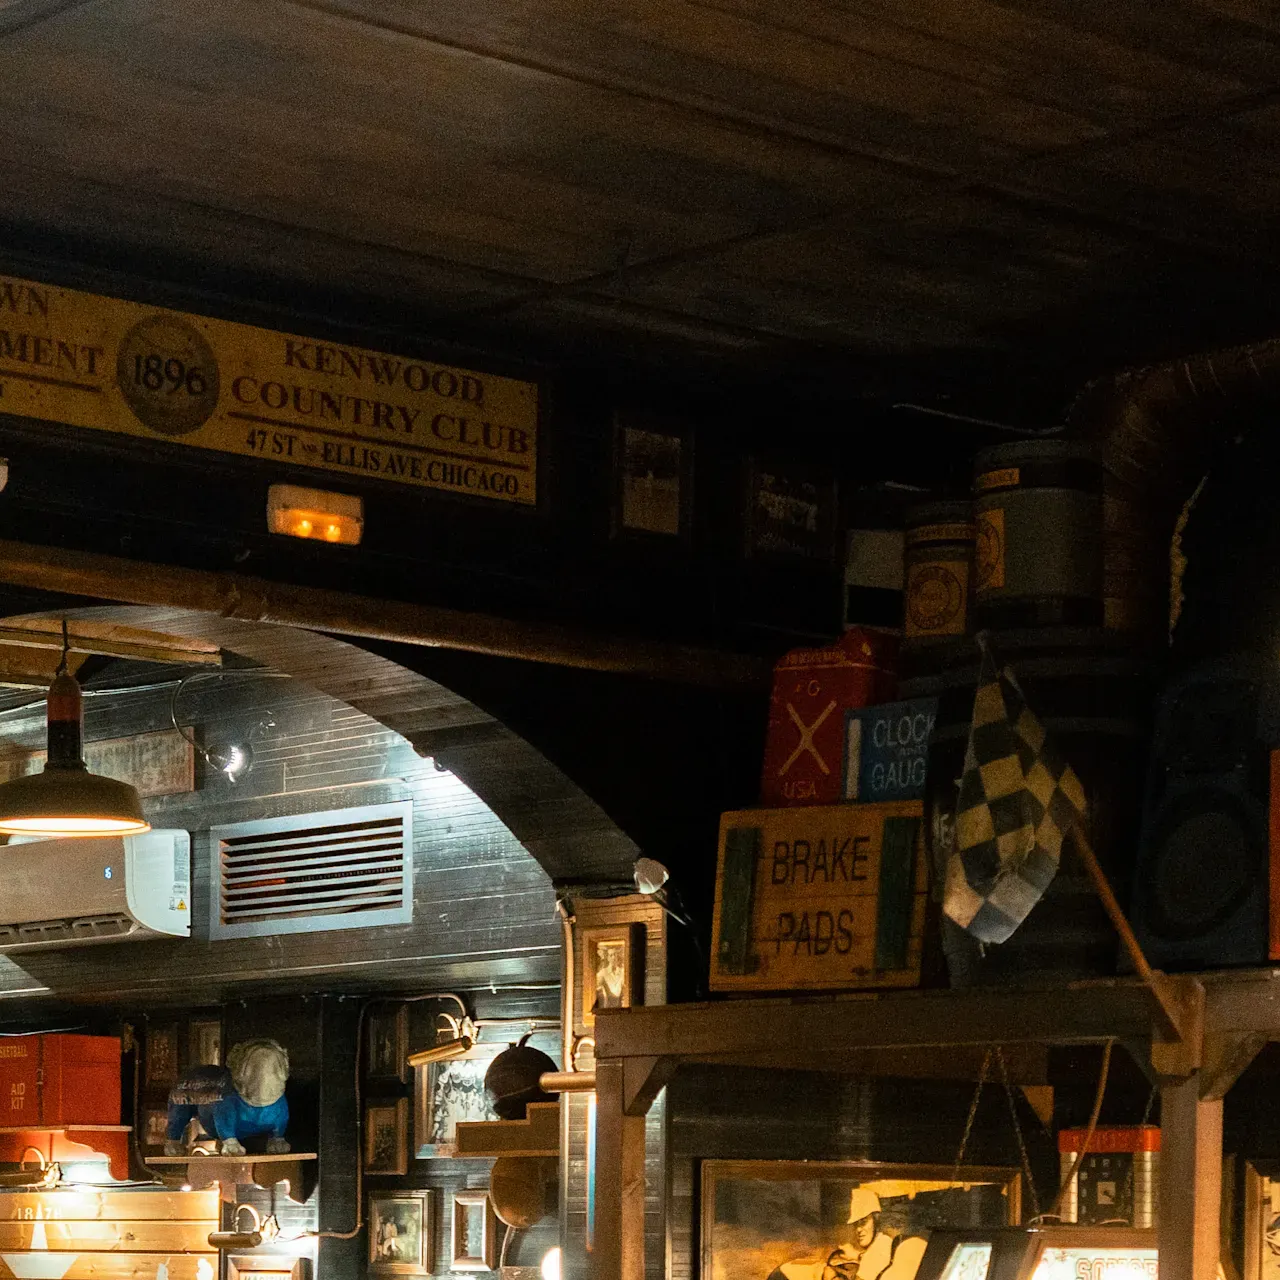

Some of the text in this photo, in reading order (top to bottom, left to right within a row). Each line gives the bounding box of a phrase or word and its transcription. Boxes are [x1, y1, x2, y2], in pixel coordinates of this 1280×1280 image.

[133, 353, 208, 397] 1896
[284, 338, 485, 406] KENWOOD
[231, 376, 530, 456] COUNTRY CLUB
[246, 429, 267, 452] 47
[271, 432, 299, 456] ST
[321, 441, 381, 472] ELLIS
[770, 835, 872, 886] BRAKE
[775, 908, 855, 957] PADS
[10, 1082, 26, 1096] AID
